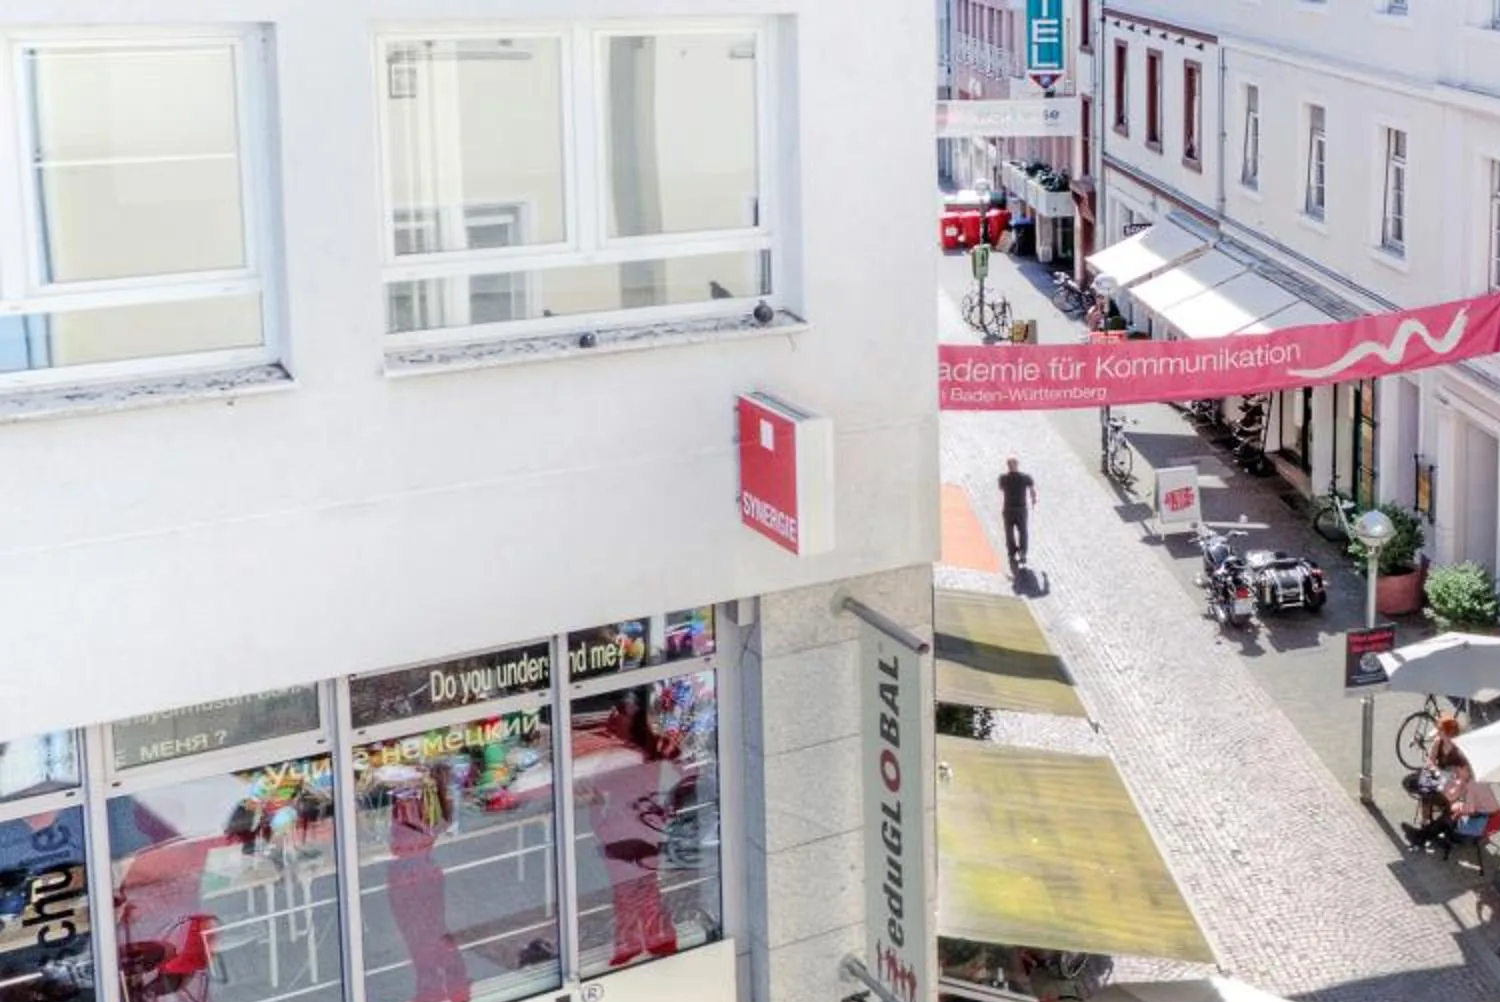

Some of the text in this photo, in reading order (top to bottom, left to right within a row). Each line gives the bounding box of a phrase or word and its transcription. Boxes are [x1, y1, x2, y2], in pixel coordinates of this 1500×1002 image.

[1047, 356, 1088, 382] für
[1095, 342, 1301, 380] Kommunikation
[950, 386, 1108, 402] Baden-Württemberg
[742, 490, 798, 544] SYNERGIE
[430, 670, 456, 703] Do
[461, 667, 491, 704] you
[140, 733, 208, 762] МЕНЯ
[263, 708, 541, 786] Учие немецкий
[878, 655, 905, 950] eduGLOBAL
